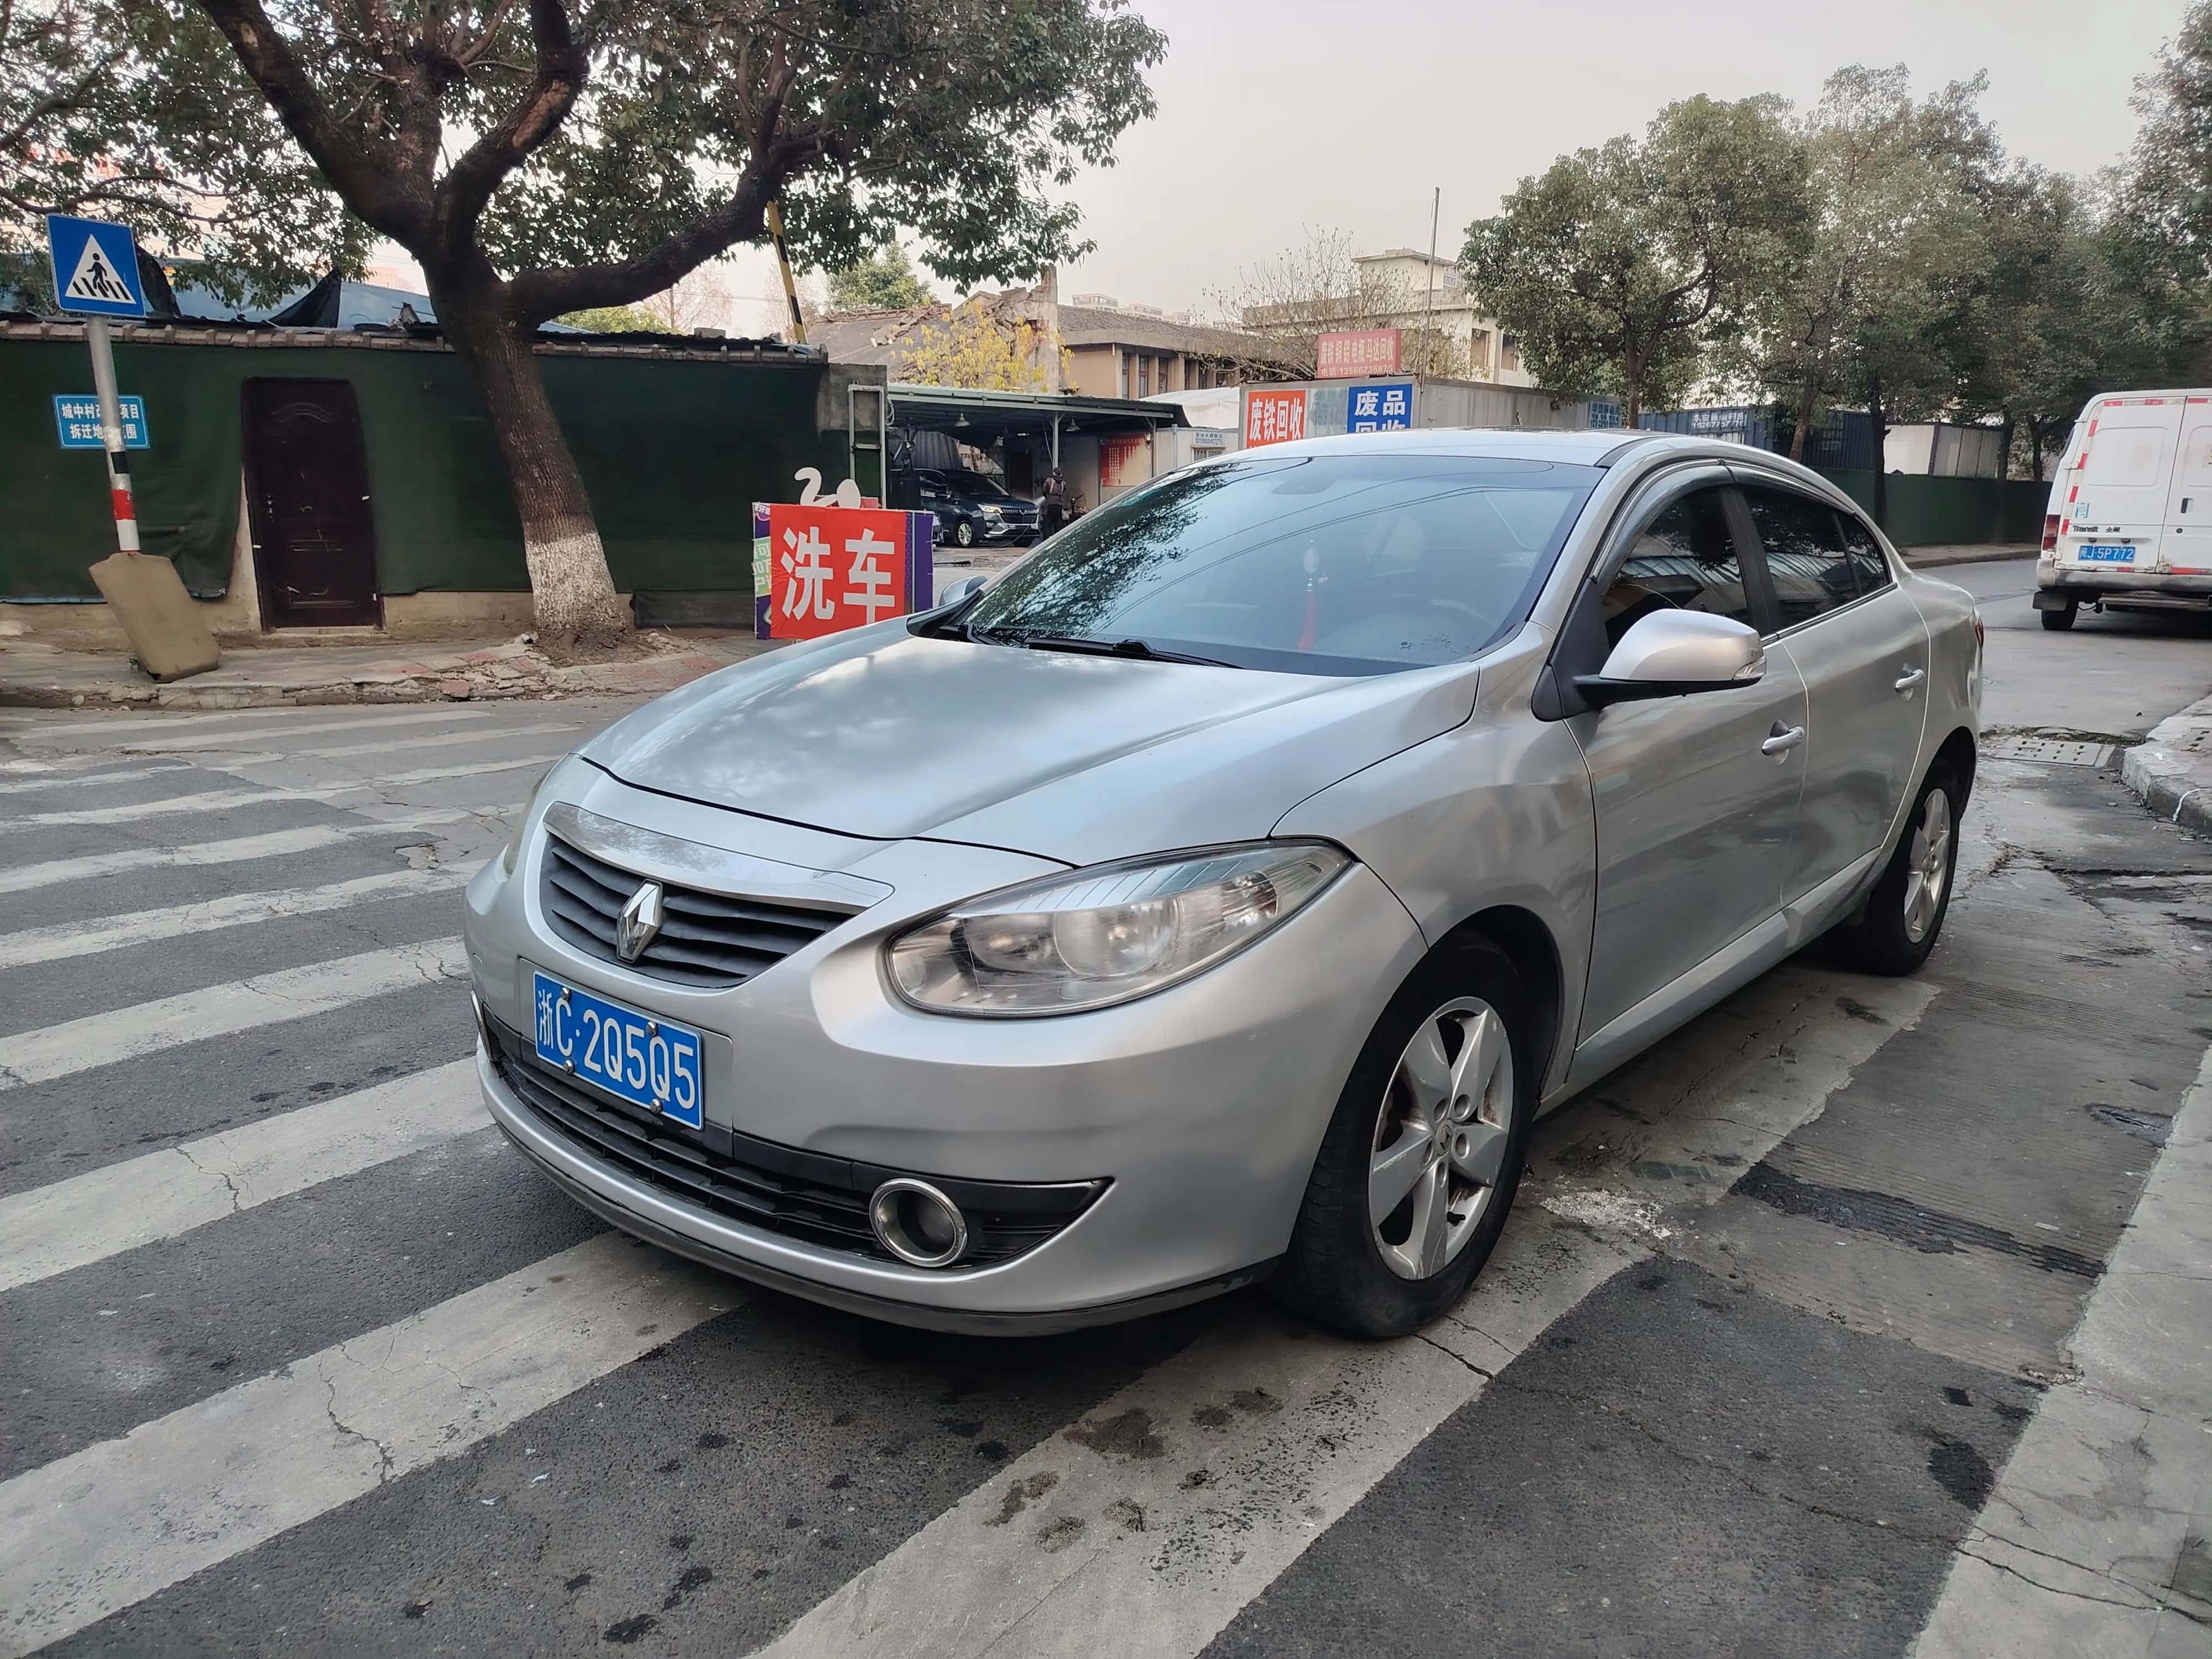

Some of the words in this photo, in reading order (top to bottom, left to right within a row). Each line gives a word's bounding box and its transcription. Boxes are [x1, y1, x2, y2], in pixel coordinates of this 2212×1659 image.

[61, 403, 139, 419] 城中村项目
[1354, 390, 1406, 417] 废品
[70, 423, 137, 440] 拆迁地围
[1249, 398, 1303, 442] 废铁回收
[780, 526, 895, 625] 洗车
